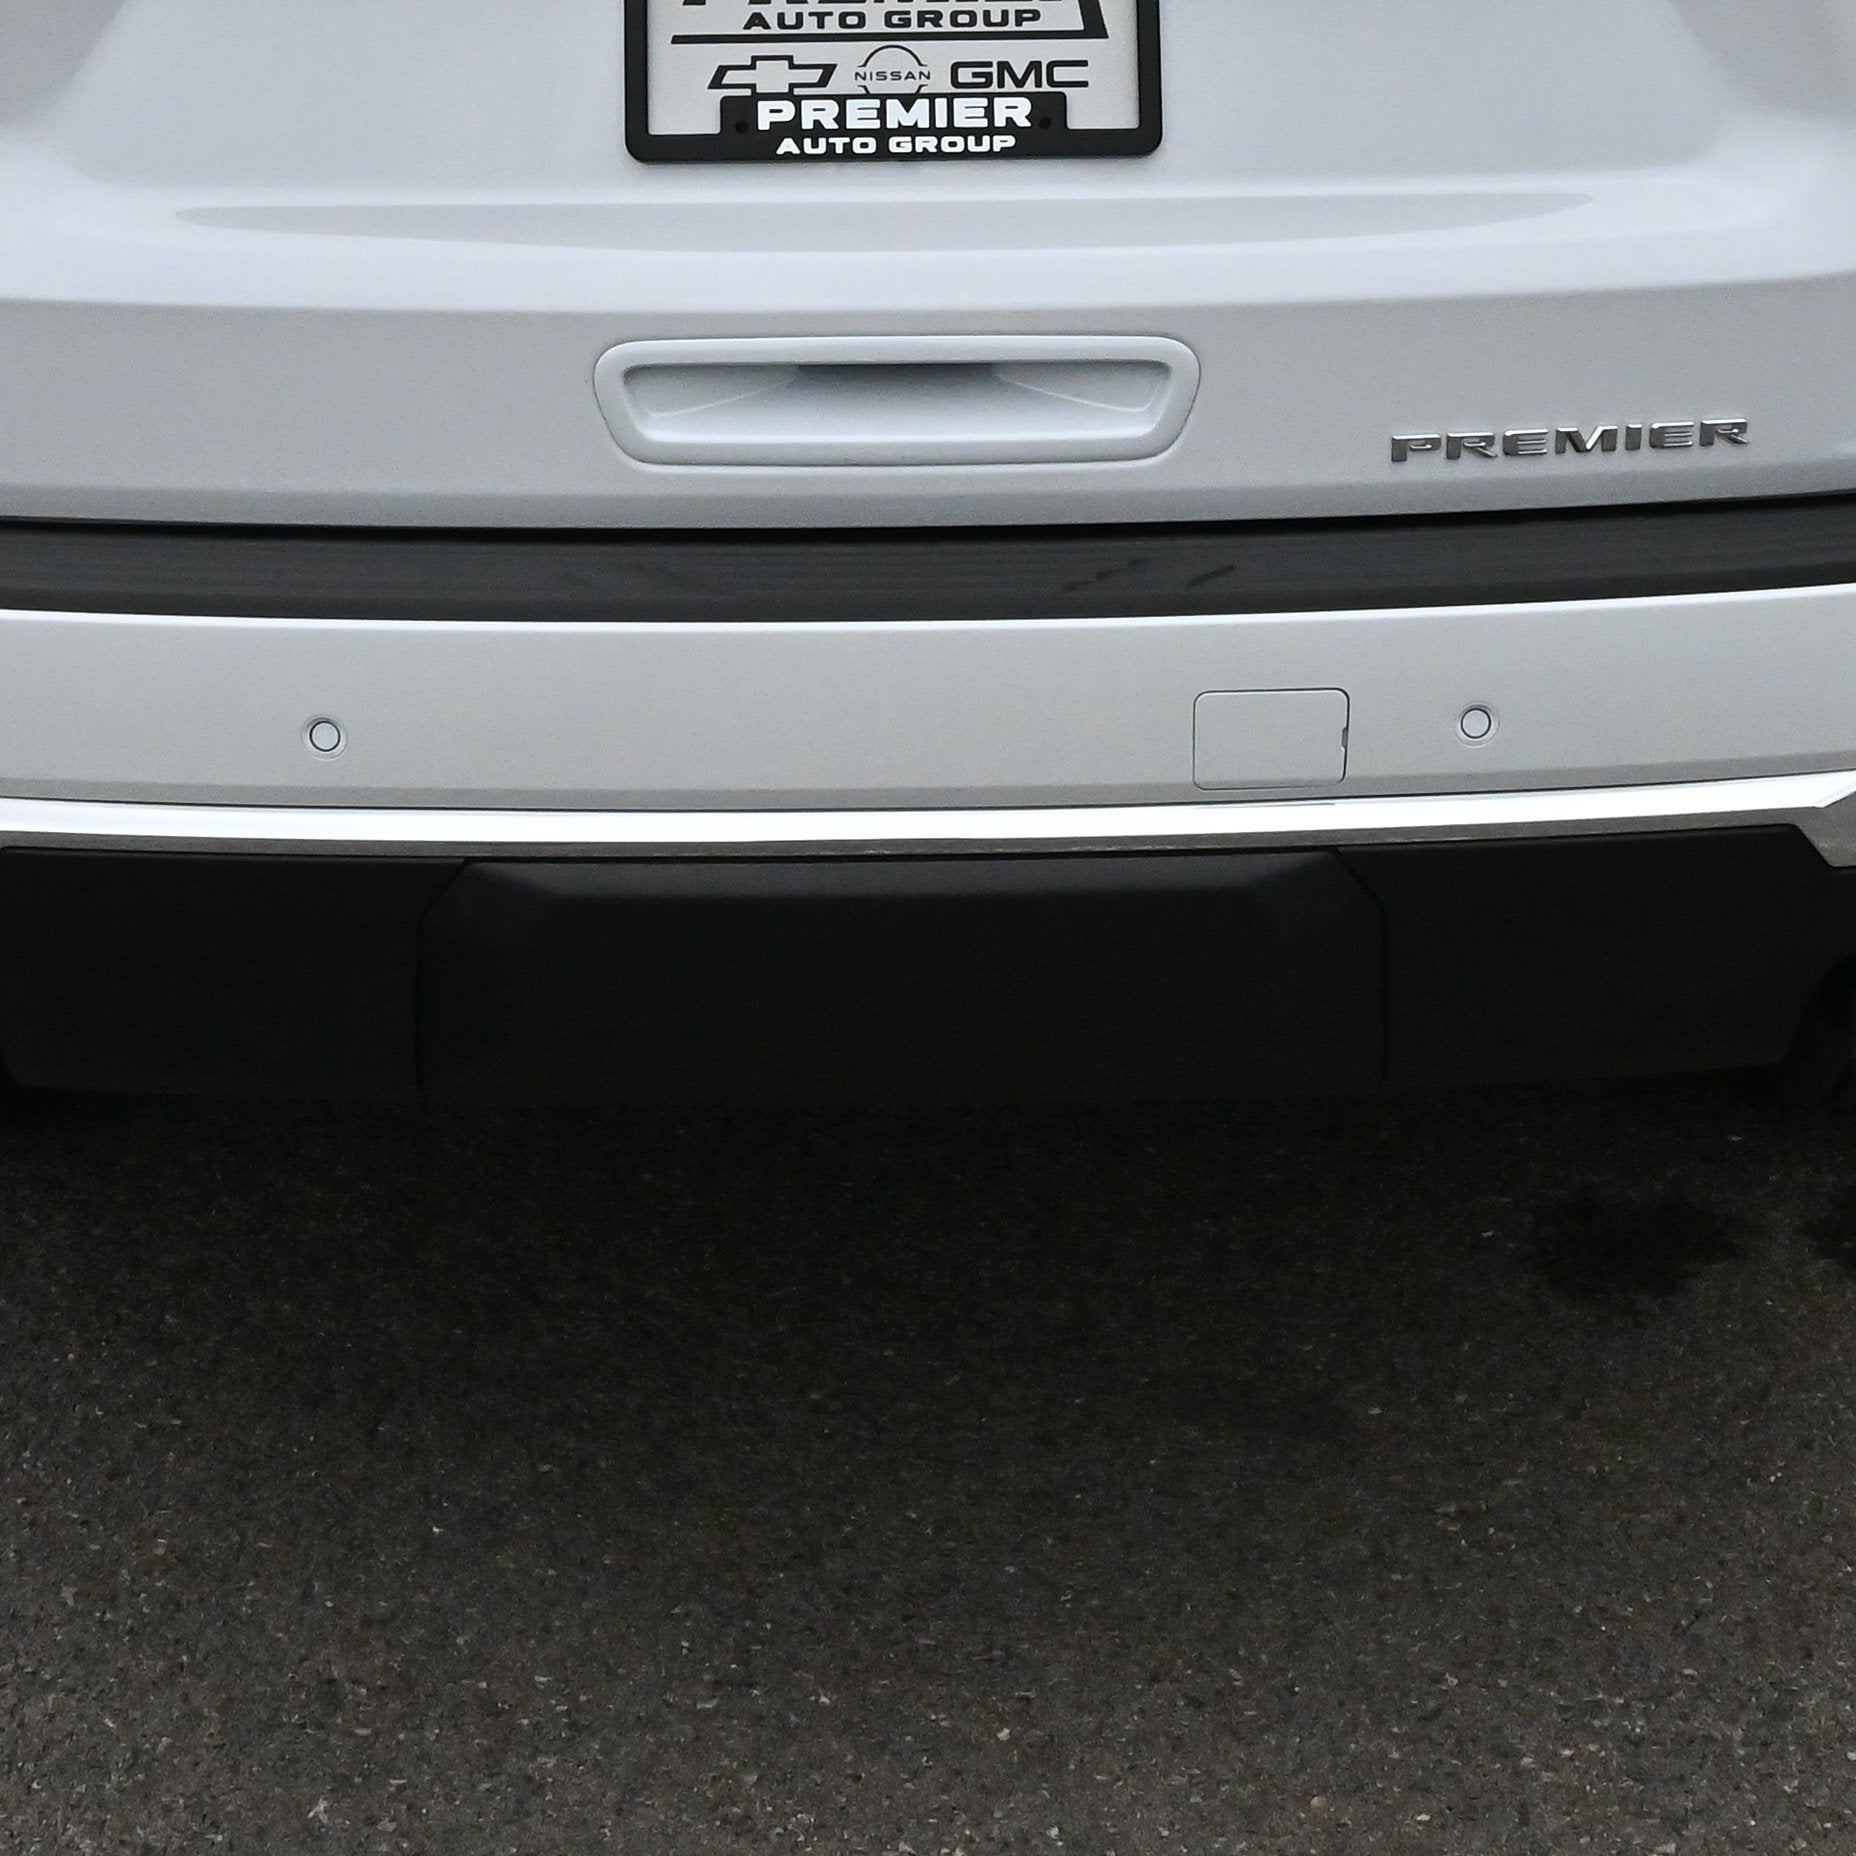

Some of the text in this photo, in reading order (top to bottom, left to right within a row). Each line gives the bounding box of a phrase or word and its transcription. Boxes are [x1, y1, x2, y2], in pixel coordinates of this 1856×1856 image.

[743, 9, 1042, 31] AUTO GROUP
[854, 69, 932, 82] NISSAN
[950, 60, 1090, 89] GMC
[756, 97, 1033, 131] PREMIER
[776, 134, 1017, 156] AUTO GROUP
[1389, 416, 1751, 463] PREMIER
